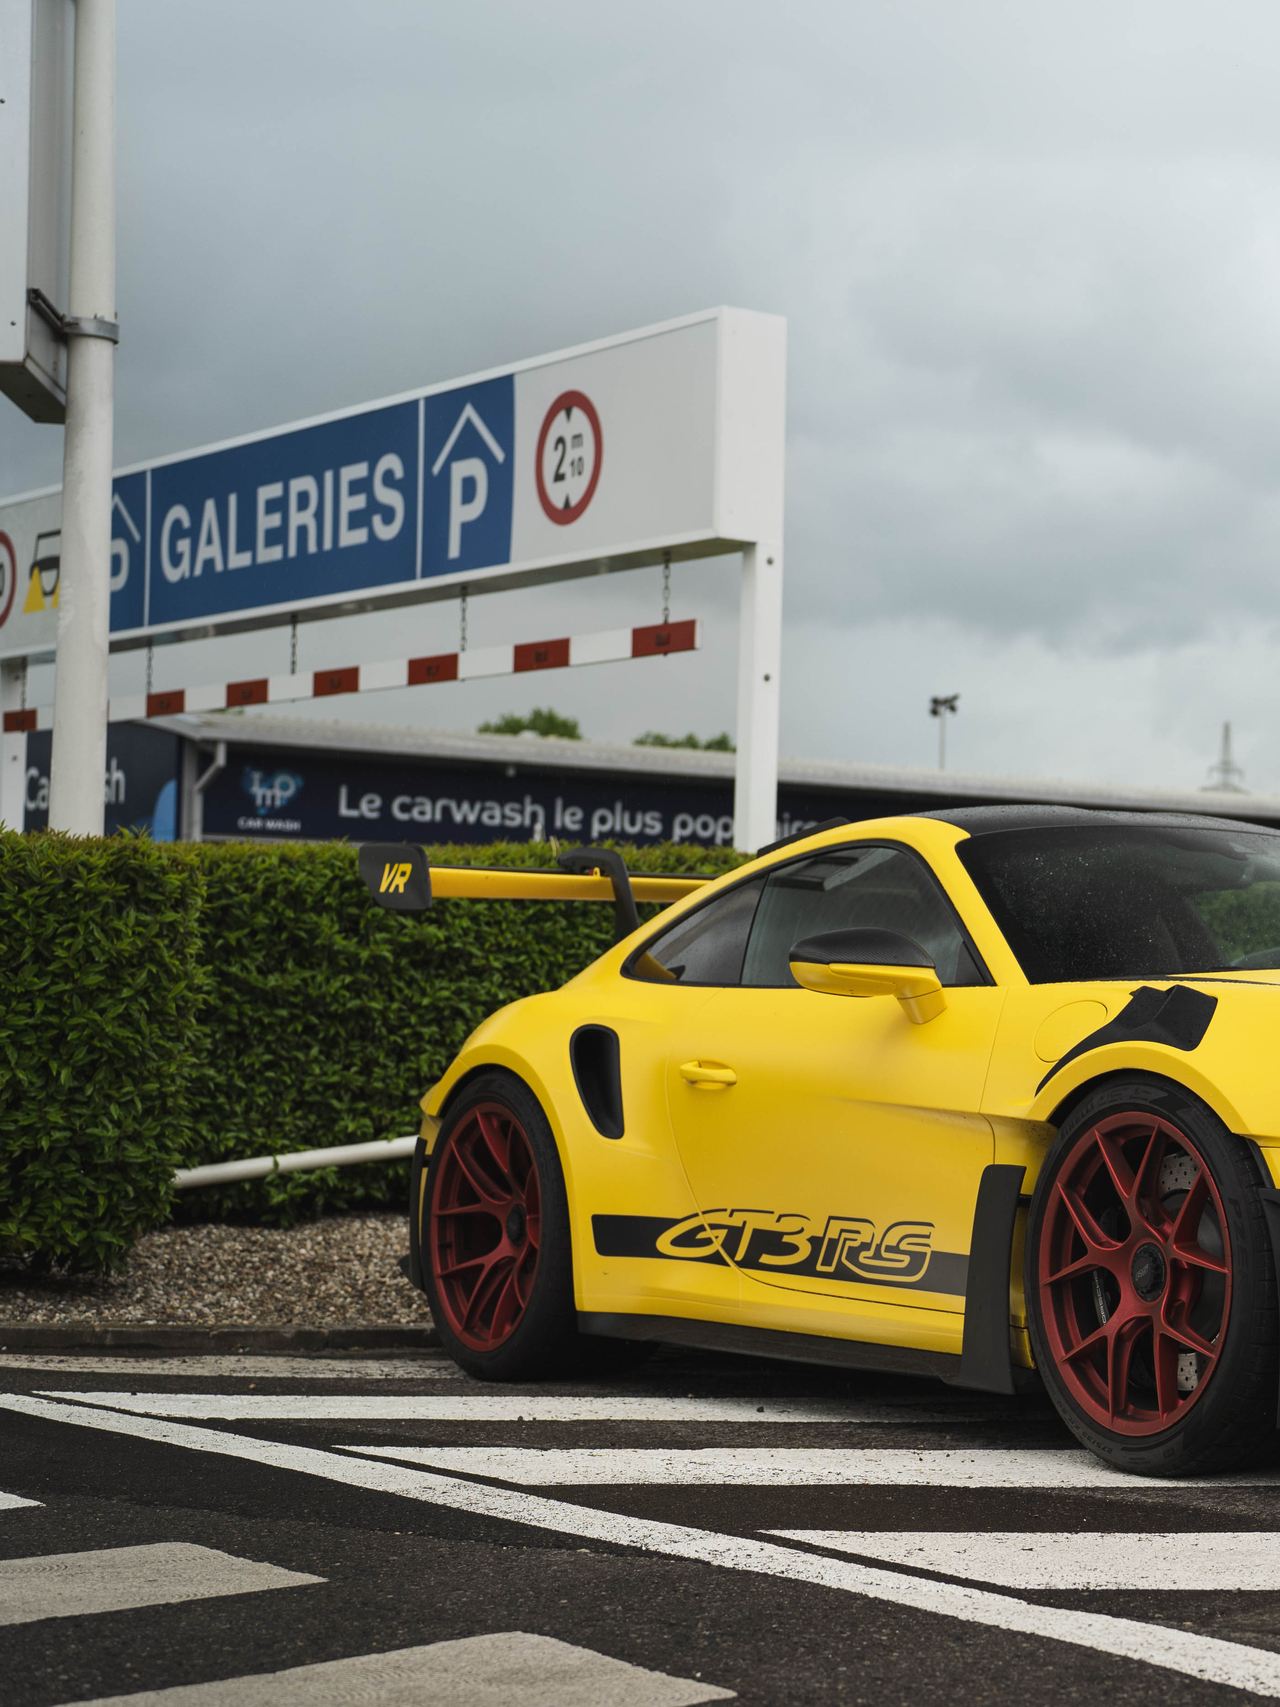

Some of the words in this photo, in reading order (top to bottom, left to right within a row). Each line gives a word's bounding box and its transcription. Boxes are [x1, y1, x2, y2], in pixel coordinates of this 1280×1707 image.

[552, 435, 567, 484] 2
[571, 432, 584, 449] m
[569, 456, 585, 478] 10
[160, 452, 405, 584] GALERIES
[447, 456, 488, 559] P
[338, 784, 382, 820] Le
[390, 787, 545, 828] carwash
[555, 797, 584, 832] le
[590, 803, 663, 839] plus
[379, 863, 413, 893] VR
